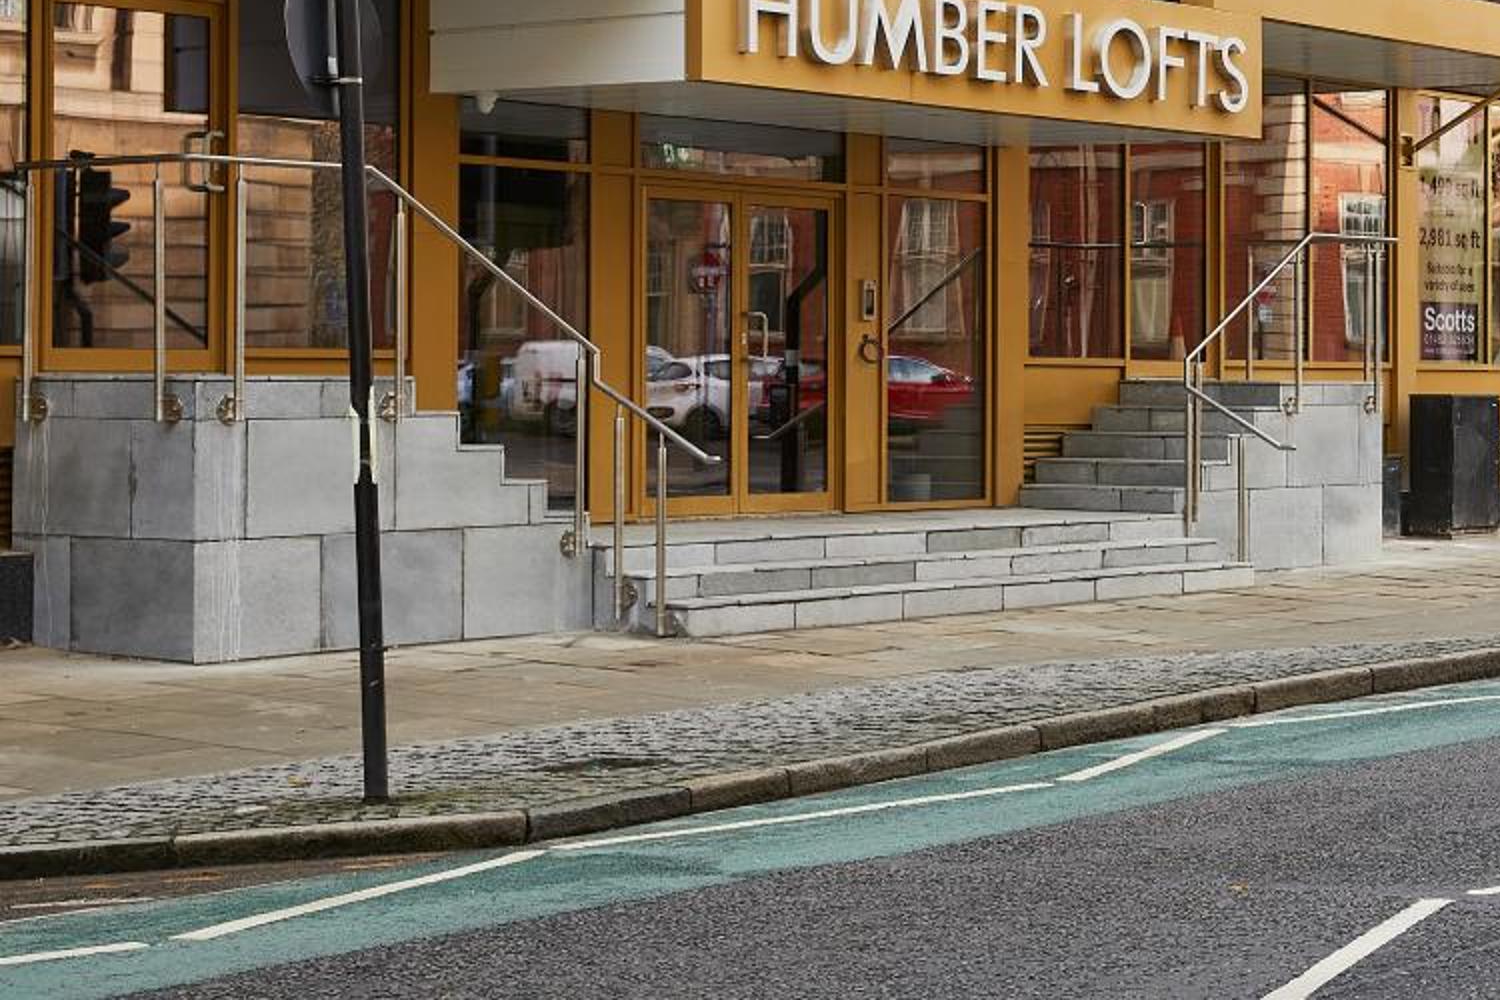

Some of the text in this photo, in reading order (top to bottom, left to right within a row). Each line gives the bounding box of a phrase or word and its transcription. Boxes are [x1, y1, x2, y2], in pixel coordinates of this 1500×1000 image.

[1065, 12, 1248, 113] LOFTS
[1419, 227, 1481, 251] 2,981 sq ft
[1424, 306, 1476, 333] Scotts
